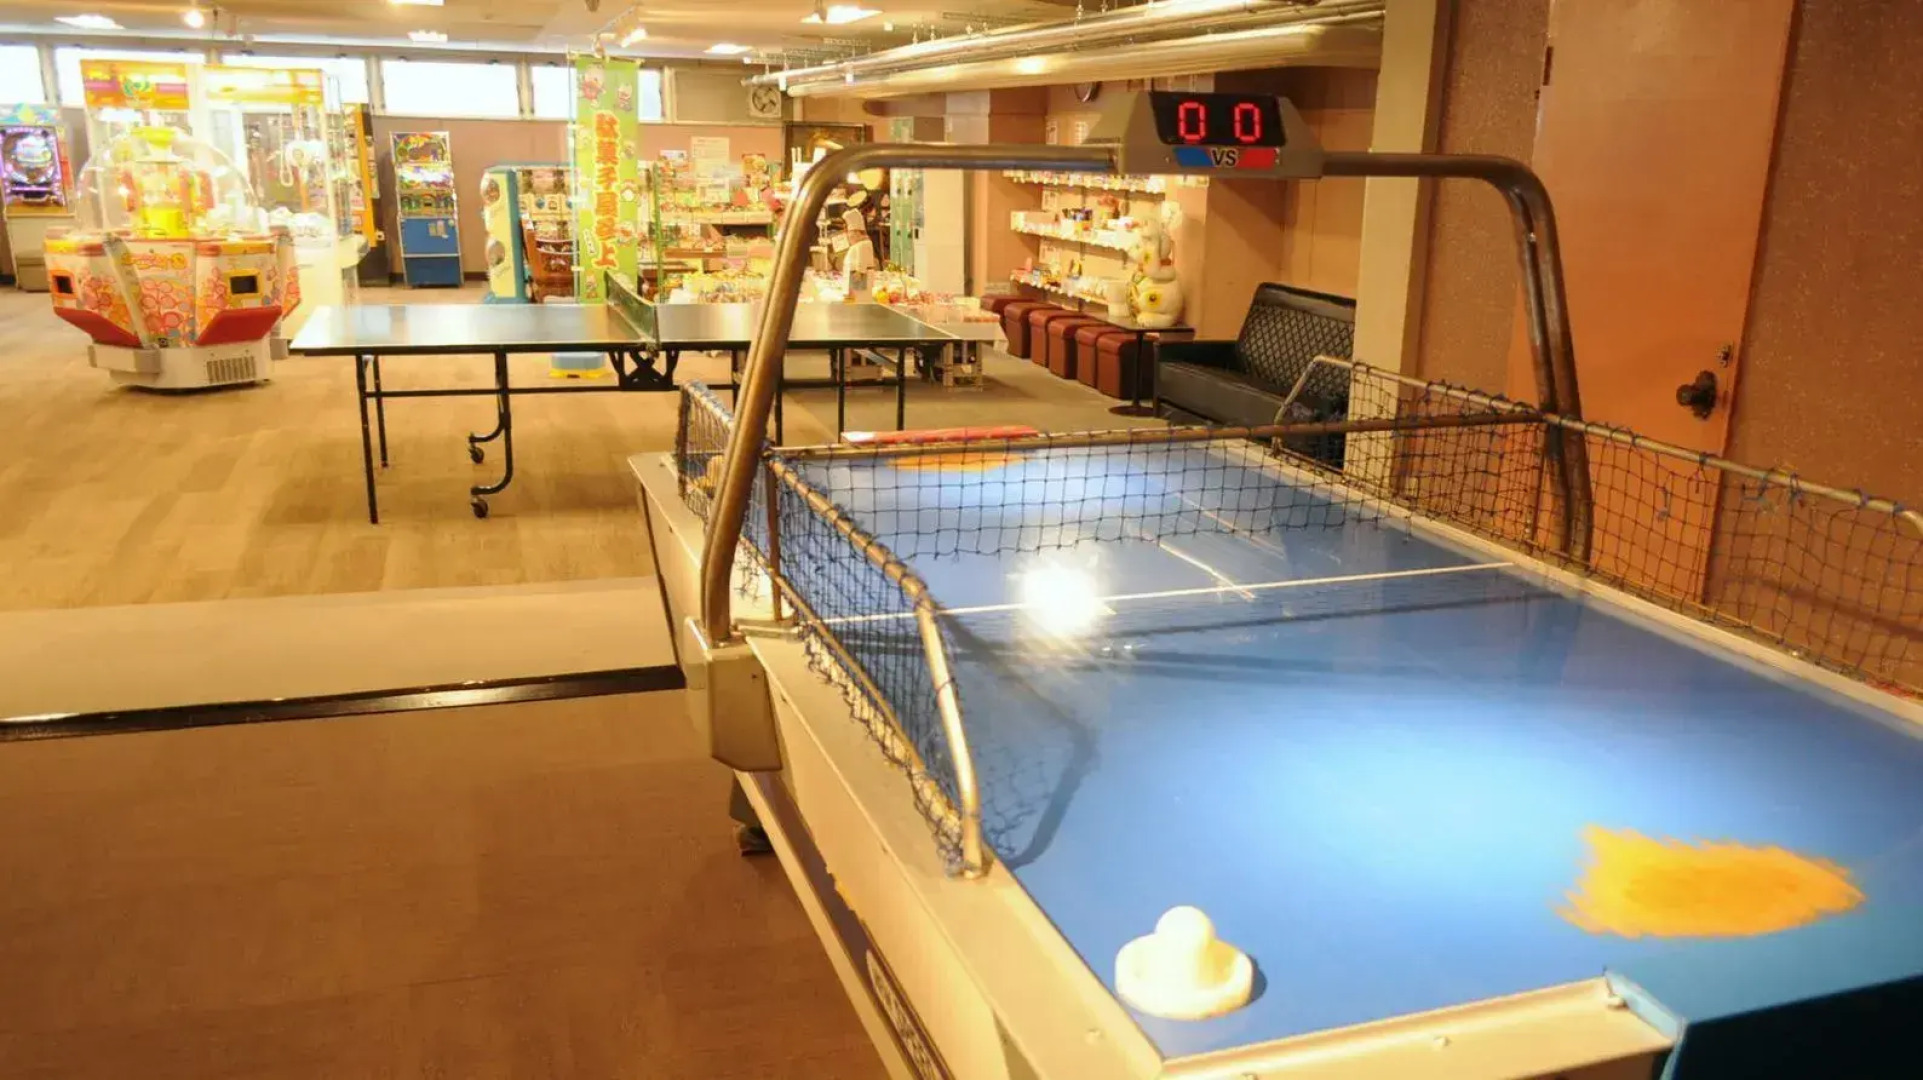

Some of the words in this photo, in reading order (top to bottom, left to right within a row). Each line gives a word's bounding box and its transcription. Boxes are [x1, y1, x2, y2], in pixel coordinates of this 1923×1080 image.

[1178, 101, 1206, 141] 0
[1233, 102, 1261, 142] 0
[1210, 149, 1238, 167] VS
